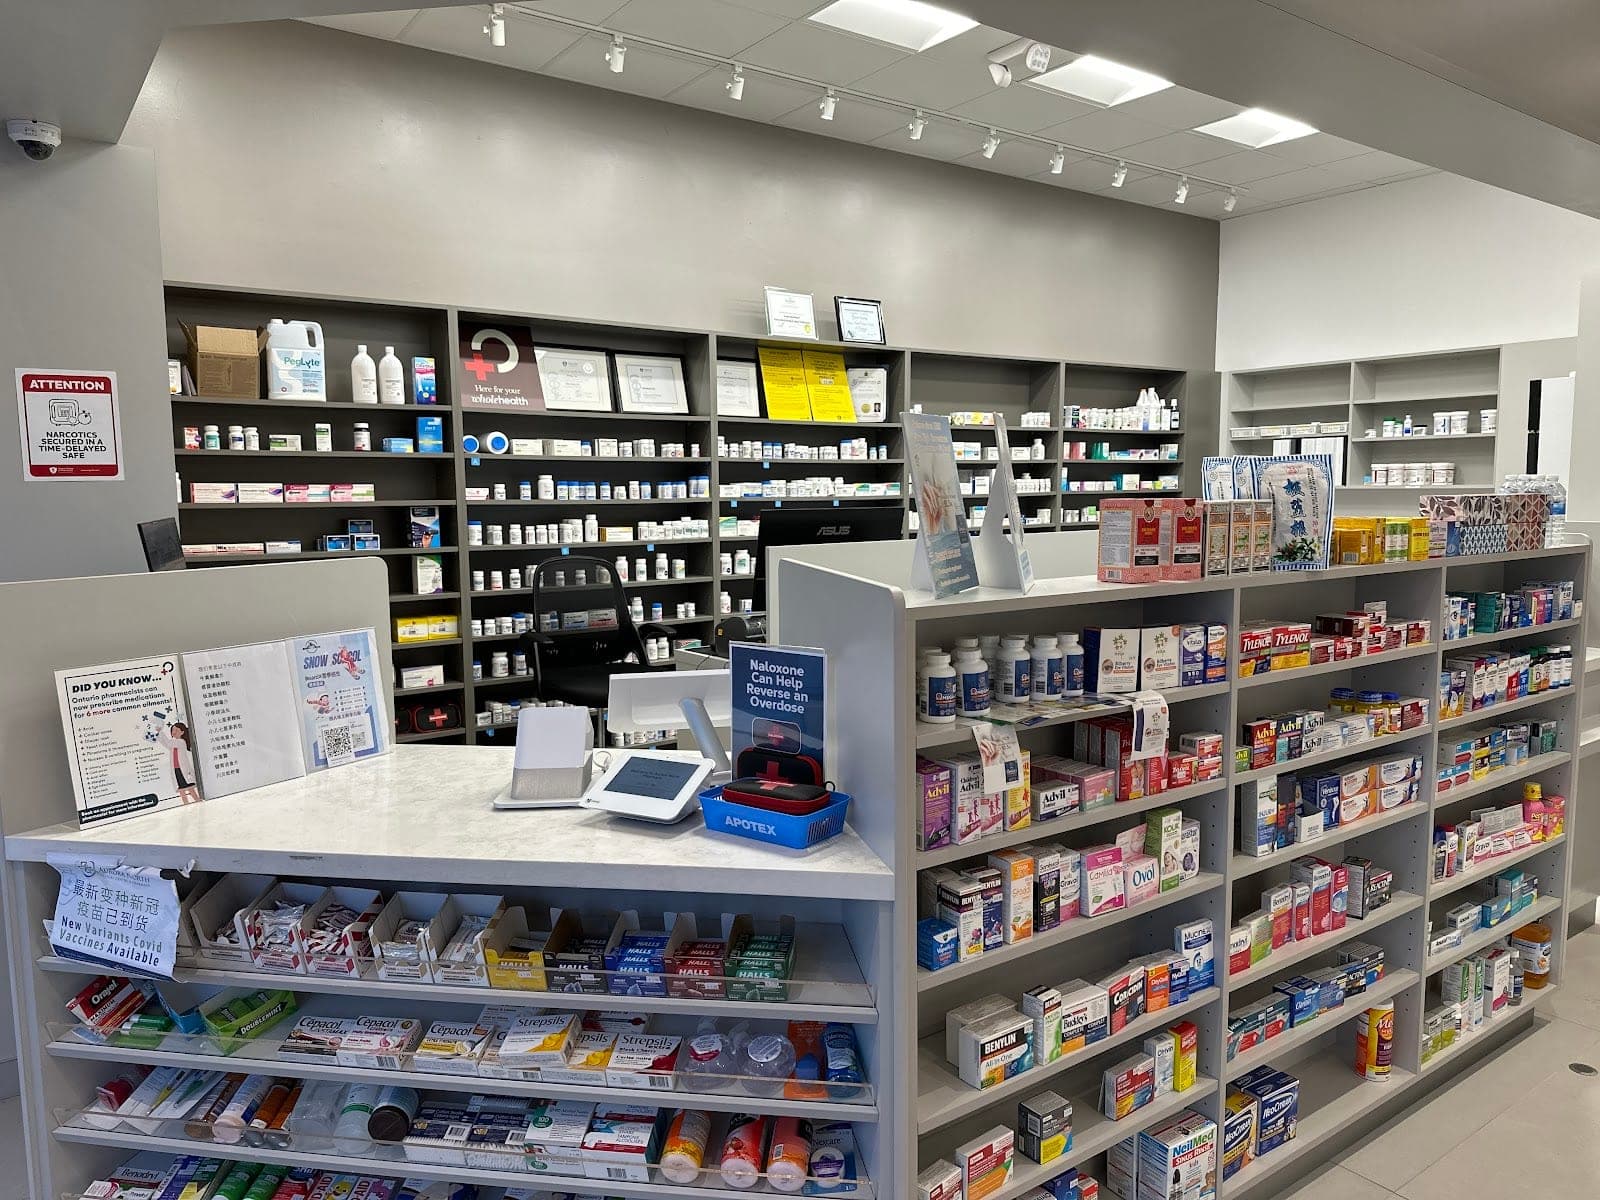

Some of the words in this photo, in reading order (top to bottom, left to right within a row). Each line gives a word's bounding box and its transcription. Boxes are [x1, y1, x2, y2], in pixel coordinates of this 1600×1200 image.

[284, 357, 320, 369] PegLyte
[30, 379, 104, 391] ATTENTION
[474, 384, 492, 393] Here
[493, 385, 504, 394] for
[504, 387, 520, 396] your
[471, 394, 529, 406] wholehealth
[46, 431, 98, 439] NARCOTICS
[38, 445, 107, 453] TIME-DELAYED
[816, 526, 851, 536] ASUS
[1243, 638, 1270, 652] TYLENOL
[1275, 633, 1309, 647] TYLENOL
[303, 654, 329, 670] SNOW
[750, 659, 805, 676] Naloxone
[72, 680, 92, 694] DID
[94, 677, 116, 690] YOU
[118, 674, 162, 687] KNOW...
[751, 672, 773, 685] Can
[776, 675, 803, 691] Help
[72, 693, 100, 704] Ontario
[101, 688, 144, 701] pharmacists
[746, 683, 791, 699] Reverse
[794, 692, 809, 702] an
[73, 704, 89, 712] now
[90, 698, 124, 710] prescribe
[124, 692, 165, 704] medications
[74, 711, 85, 719] for
[112, 704, 141, 713] common
[142, 698, 173, 708] ailments!
[750, 695, 805, 714] Overdose
[1280, 721, 1302, 733] Advil
[1306, 717, 1324, 729] Advil
[1255, 728, 1275, 739] Advil
[1304, 737, 1322, 750] Advil
[1235, 750, 1248, 760] dvil
[927, 784, 950, 798] Advil
[960, 782, 980, 793] Advil
[1043, 789, 1066, 803] Advil
[724, 815, 777, 837] APOTEX
[1133, 864, 1155, 887] Ovol
[72, 879, 160, 915] 最新变种新冠
[962, 894, 982, 906] BENYLIN
[77, 900, 149, 934] 疫苗已到货
[61, 915, 82, 931] New
[85, 922, 130, 944] Variants
[133, 936, 162, 953] Covid
[1184, 927, 1211, 940] Mucinex
[59, 928, 104, 951] Vaccines
[107, 943, 160, 967] Available
[500, 961, 530, 970] HALLS
[559, 963, 589, 971] HALLS
[619, 966, 651, 974] HALLS
[678, 968, 710, 977] HALLS
[738, 970, 770, 979] HALLS
[91, 982, 117, 1005] Orajel
[1114, 980, 1143, 1005] CORICIDIN
[240, 1005, 283, 1036] DOUBLEMINT
[518, 1016, 565, 1028] Strepsils
[1063, 1013, 1088, 1030] Buckley's
[577, 1033, 608, 1044] epsils
[1063, 1027, 1084, 1038] COMPLETE
[621, 1035, 673, 1048] Strepsils
[985, 1033, 1016, 1054] BENYLIN
[812, 1137, 841, 1146] Nexcare
[1172, 1129, 1214, 1157] NeilMed
[1175, 1153, 1193, 1166] SINUS
[1194, 1144, 1212, 1160] RINSE
[121, 1168, 160, 1180] Benadryl
